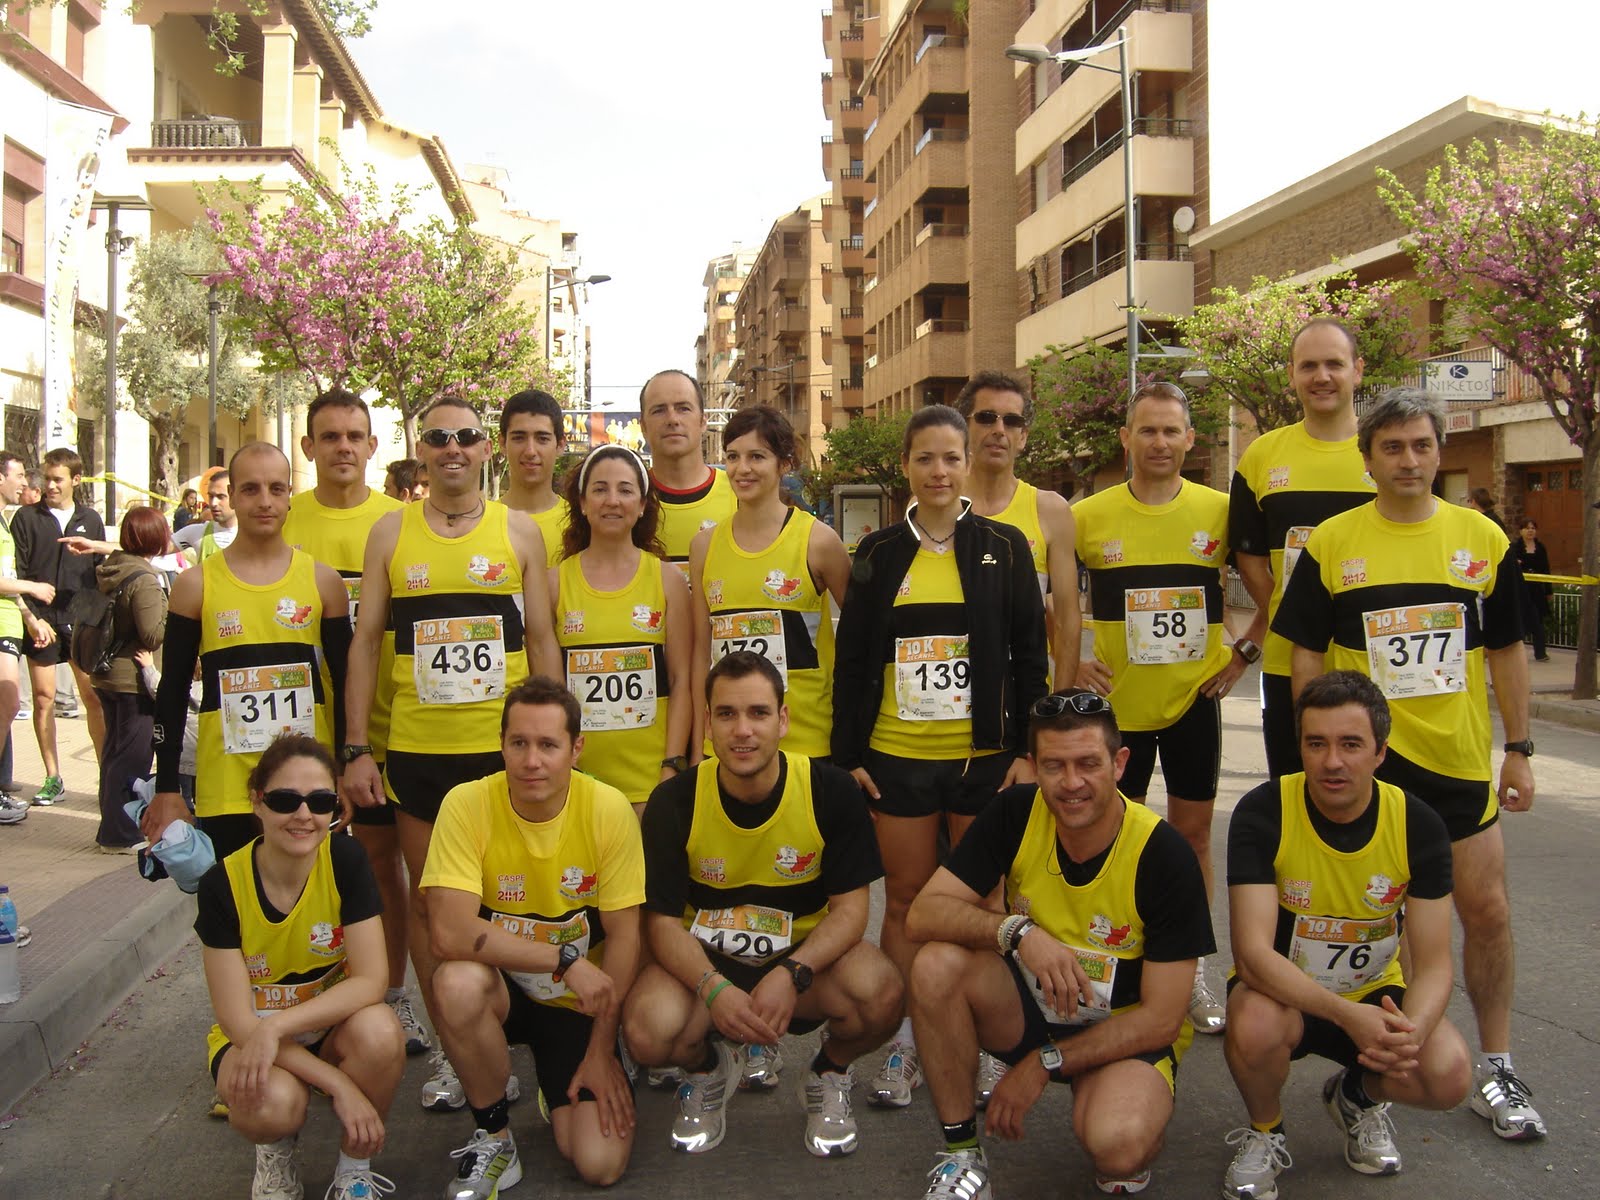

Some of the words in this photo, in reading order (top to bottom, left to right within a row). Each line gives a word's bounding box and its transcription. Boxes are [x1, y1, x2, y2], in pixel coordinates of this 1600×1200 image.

[1429, 380, 1490, 392] NIKETOS
[576, 414, 588, 433] K
[1133, 592, 1145, 605] 10
[1149, 591, 1161, 603] K
[1152, 612, 1187, 639] 58
[1376, 613, 1392, 628] 10
[1395, 609, 1409, 624] K
[422, 622, 437, 637] 10
[438, 620, 450, 634] K
[905, 641, 921, 656] 10
[923, 639, 935, 653] K
[1388, 632, 1452, 667] 377
[431, 643, 492, 674] 436
[575, 653, 590, 667] 10
[592, 651, 604, 665] K
[229, 671, 245, 686] 10
[247, 669, 260, 684] K
[915, 660, 970, 692] 139
[585, 673, 643, 703] 206
[241, 690, 298, 723] 311
[498, 874, 526, 882] CASPE
[1282, 878, 1312, 888] CASPE
[502, 919, 520, 934] 10
[522, 920, 537, 935] K
[1307, 920, 1326, 933] 10
[1329, 920, 1344, 934] K
[710, 930, 774, 958] 129
[1327, 943, 1372, 970] 76
[263, 987, 282, 1001] 10
[284, 987, 299, 1000] K
